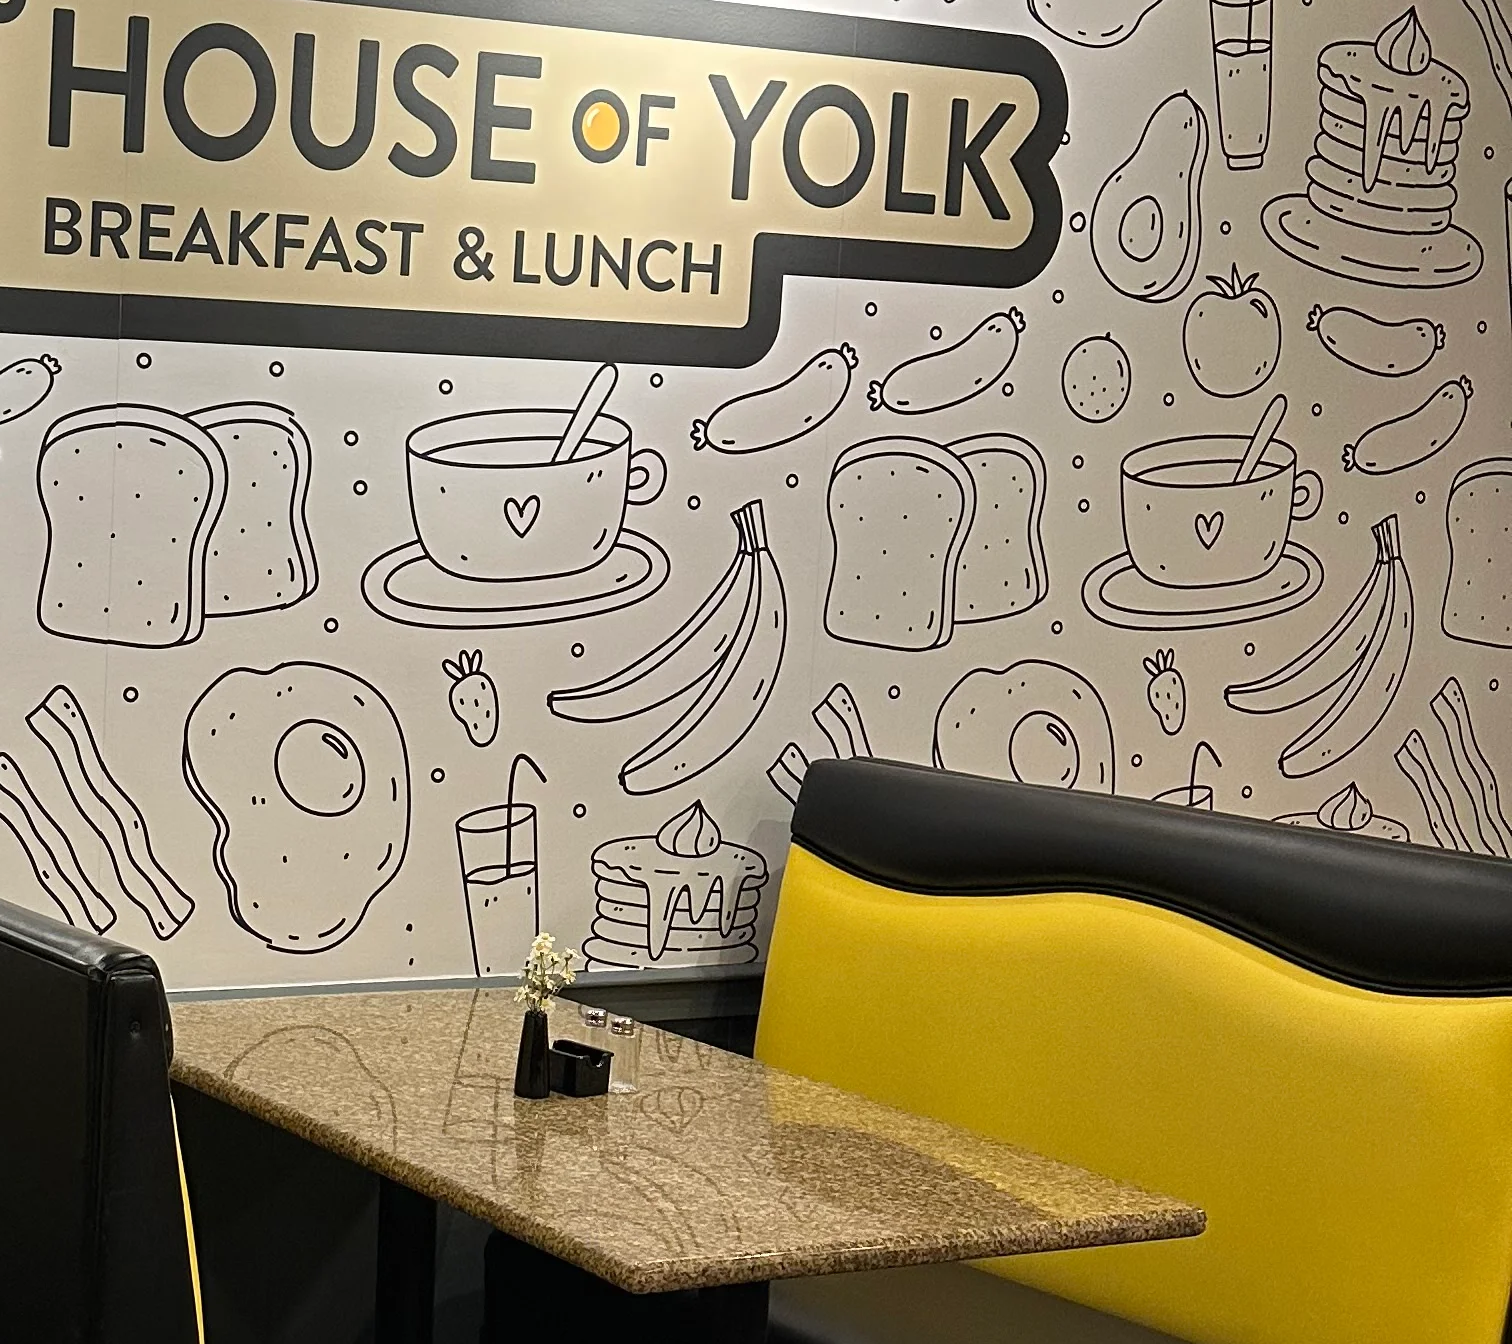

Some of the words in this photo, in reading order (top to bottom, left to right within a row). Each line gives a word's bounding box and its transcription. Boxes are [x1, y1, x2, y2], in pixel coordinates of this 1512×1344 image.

[47, 7, 543, 185] HOUSE
[573, 88, 676, 167] OF
[709, 73, 1017, 221] YOLK
[44, 196, 425, 276] BREAKFAST
[453, 226, 495, 283] &
[512, 230, 722, 295] LUNCH
